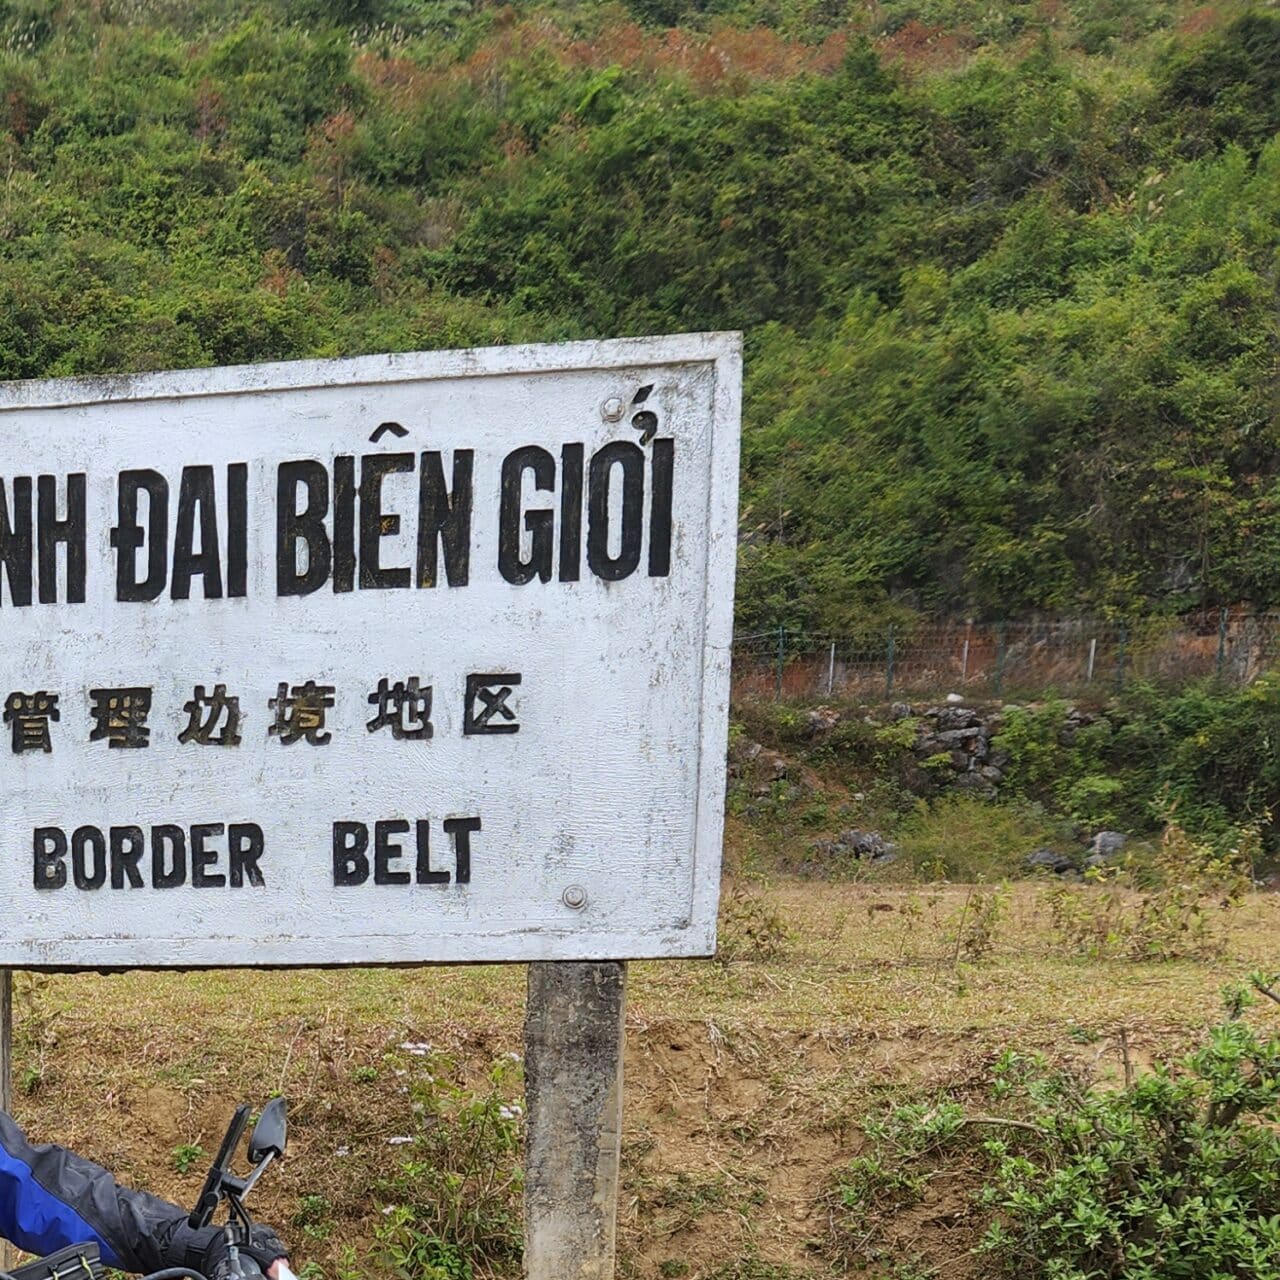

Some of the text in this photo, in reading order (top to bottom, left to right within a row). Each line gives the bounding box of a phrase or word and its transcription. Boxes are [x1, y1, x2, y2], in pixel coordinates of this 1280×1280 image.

[110, 462, 248, 603] ĐAI
[276, 421, 474, 597] BIÊN
[497, 383, 675, 585] GIỚI
[33, 816, 482, 891] BORDER BELT
